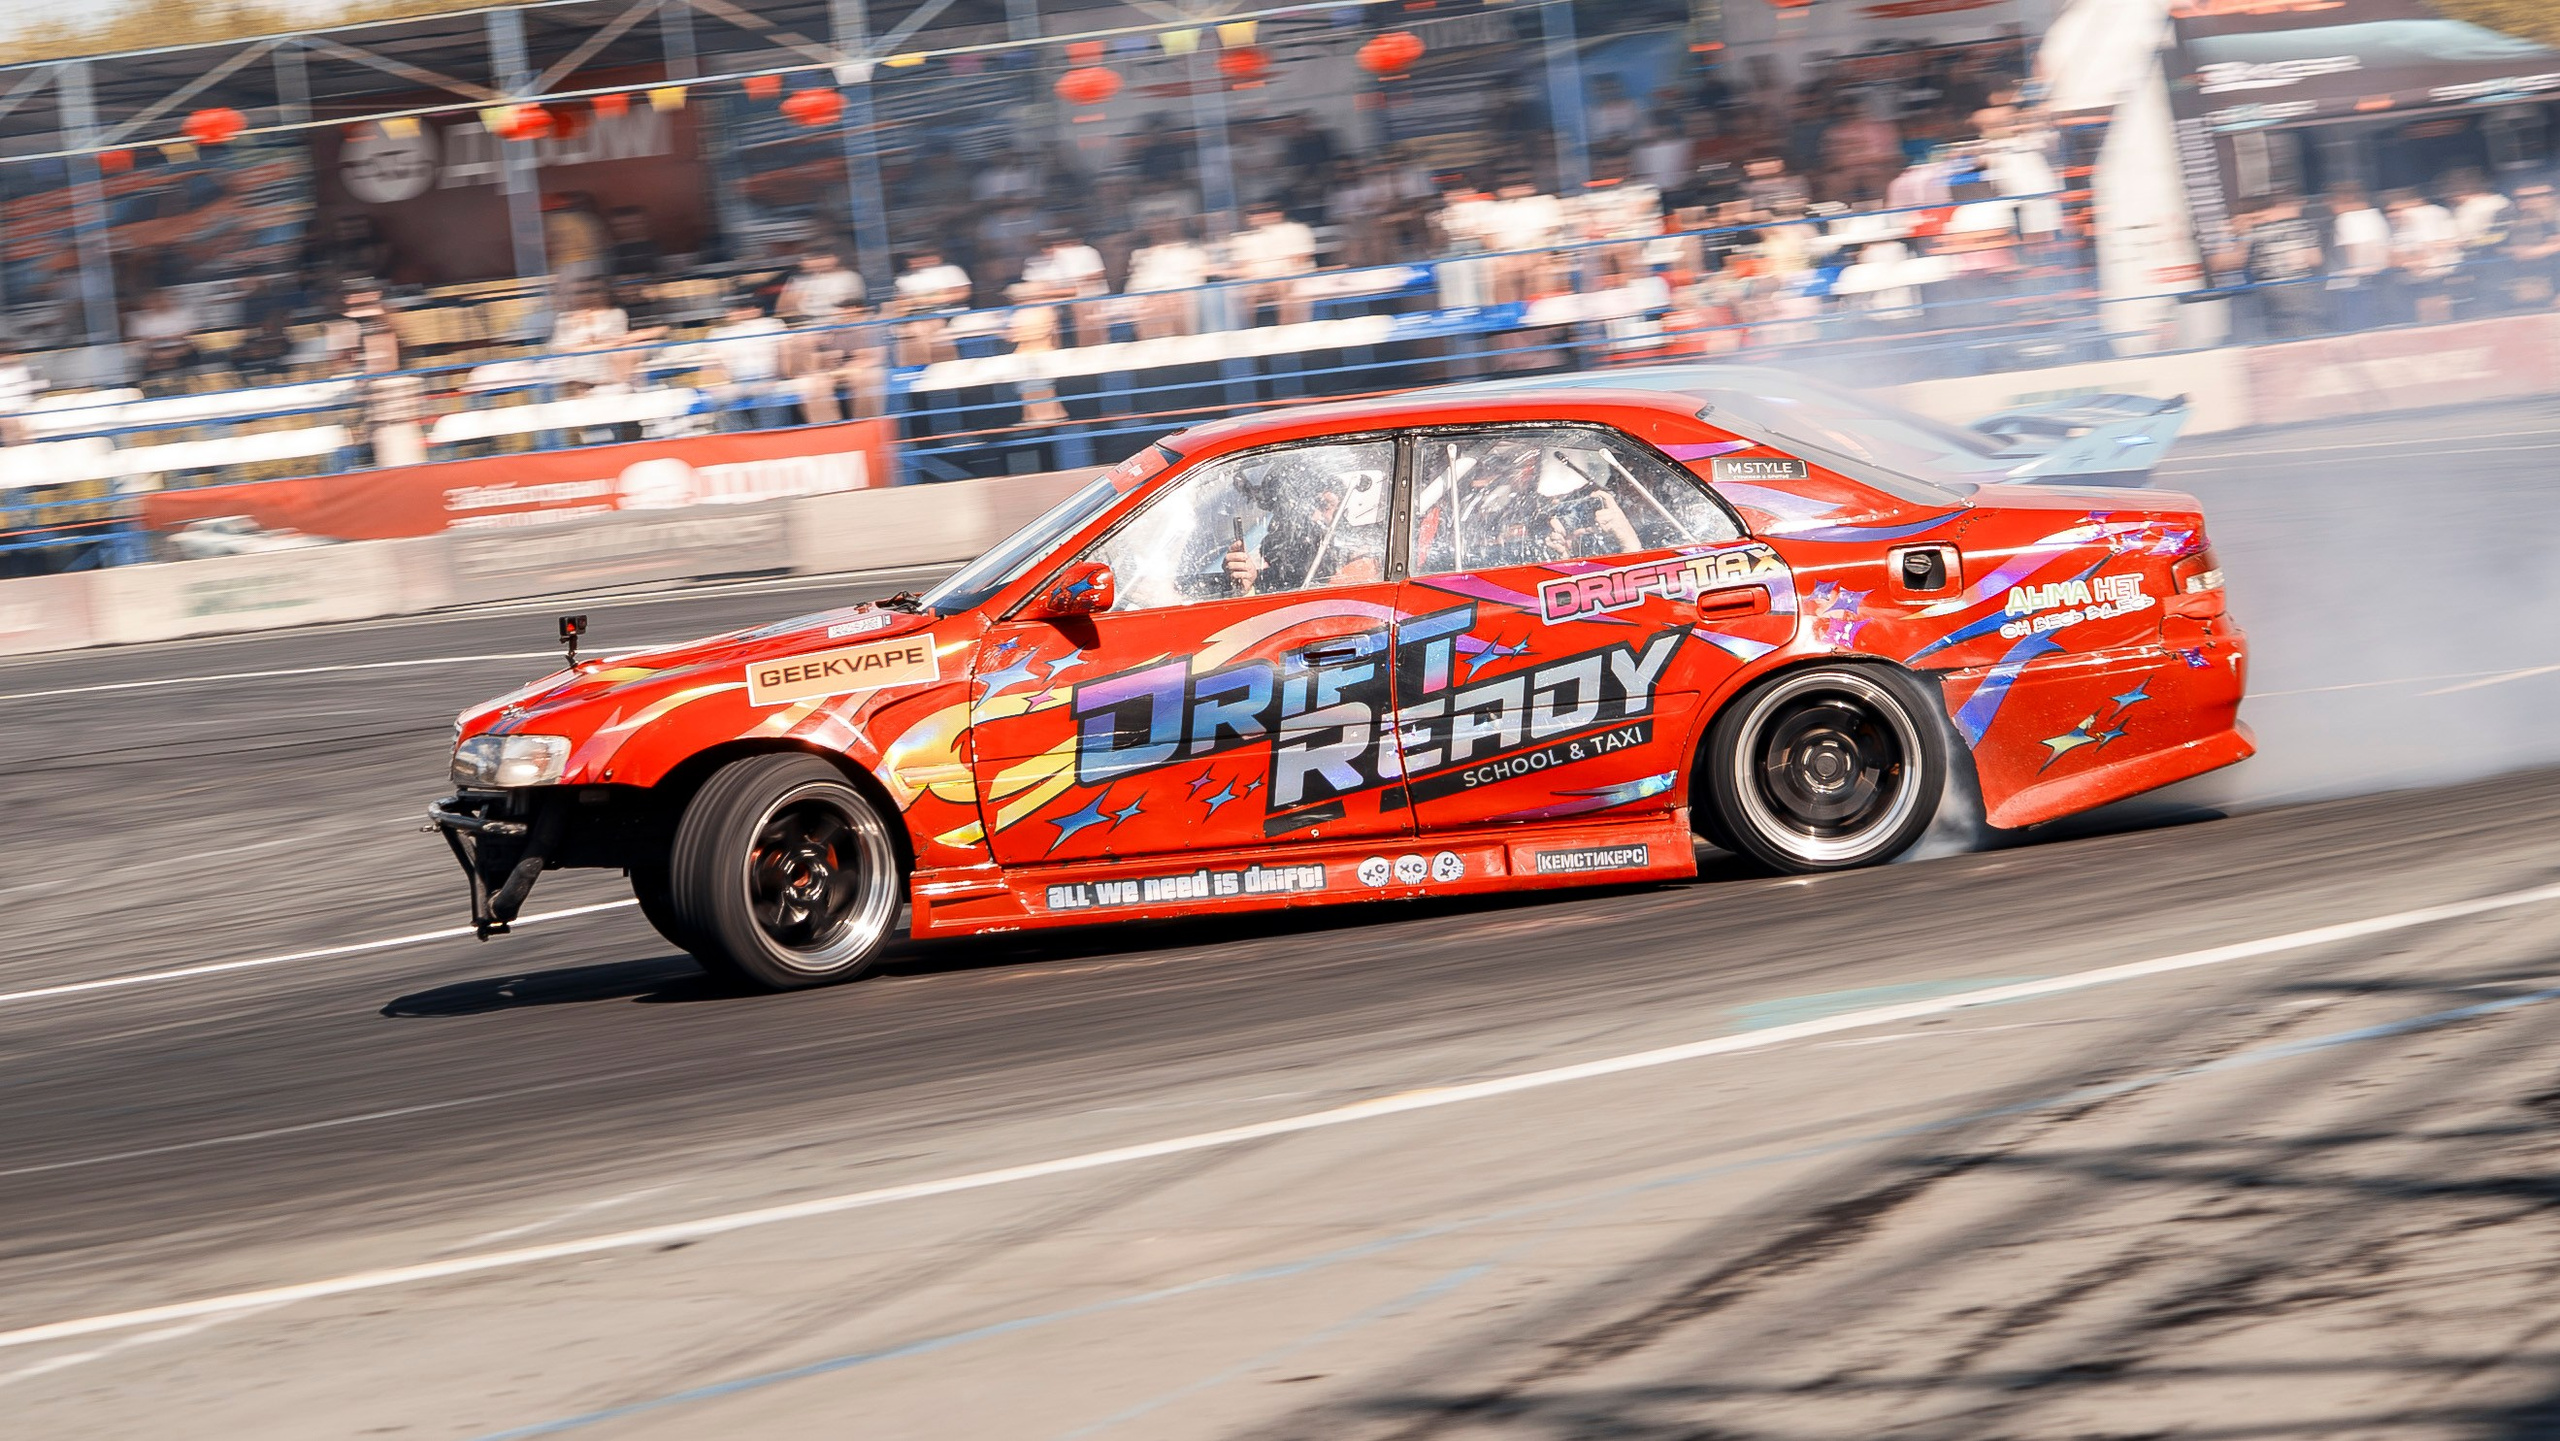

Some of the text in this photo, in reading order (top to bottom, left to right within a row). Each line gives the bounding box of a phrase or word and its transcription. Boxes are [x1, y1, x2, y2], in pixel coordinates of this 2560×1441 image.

[2005, 573, 2144, 616] ДЫМА НЕТ
[2000, 619, 2032, 639] ОН
[2033, 609, 2085, 633] ВЕСЬ
[760, 646, 925, 688] GEEKVAPE
[1075, 606, 1473, 785] DRIFT
[1272, 632, 1682, 808] READY
[1463, 726, 1643, 787] SCHOOL & TAXI
[1095, 881, 1140, 905] we
[1144, 870, 1209, 901] need
[1214, 873, 1239, 896] is
